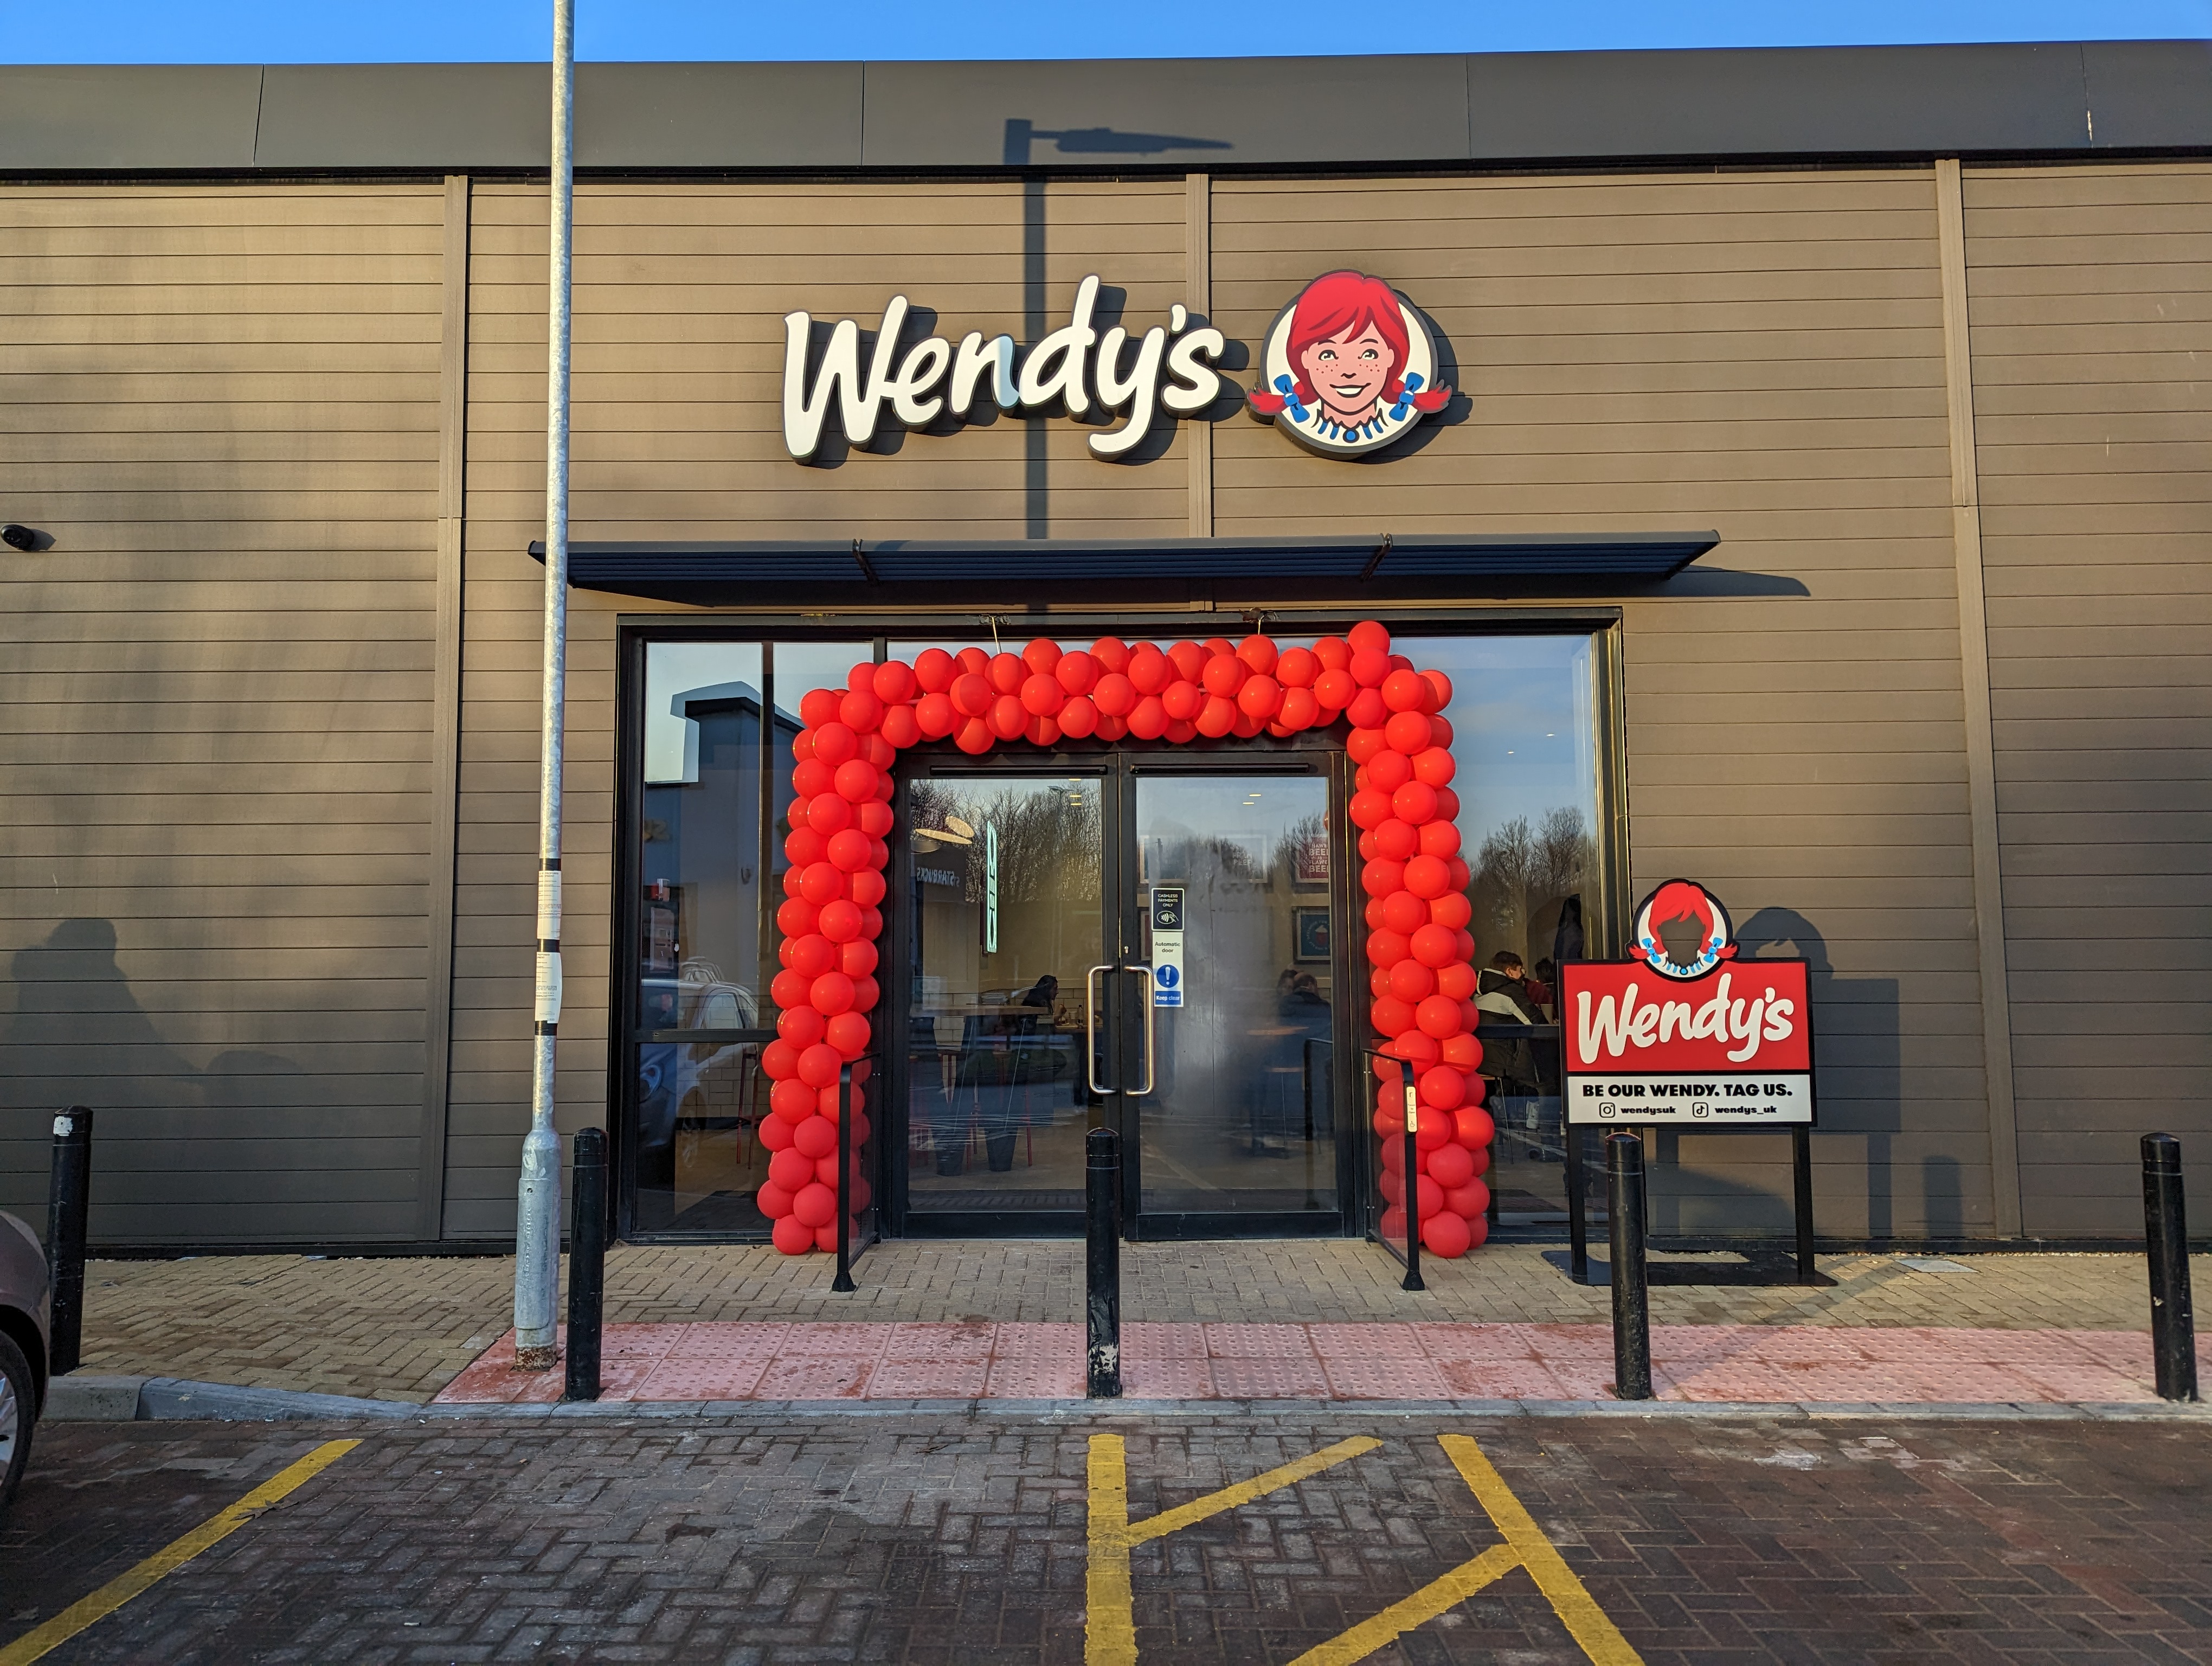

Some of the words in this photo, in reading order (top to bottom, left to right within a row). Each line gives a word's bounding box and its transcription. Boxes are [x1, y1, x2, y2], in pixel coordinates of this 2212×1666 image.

[784, 274, 1224, 459] Wendy's
[1577, 973, 1794, 1064] Wendy's
[1583, 1085, 1604, 1097] BE
[1608, 1085, 1646, 1097] OUR
[1649, 1084, 1720, 1097] WENDY.
[1724, 1084, 1760, 1096] TAG
[1764, 1084, 1793, 1096] US.
[1621, 1106, 1676, 1115] wendysuk
[1714, 1105, 1777, 1114] wendys_uk
